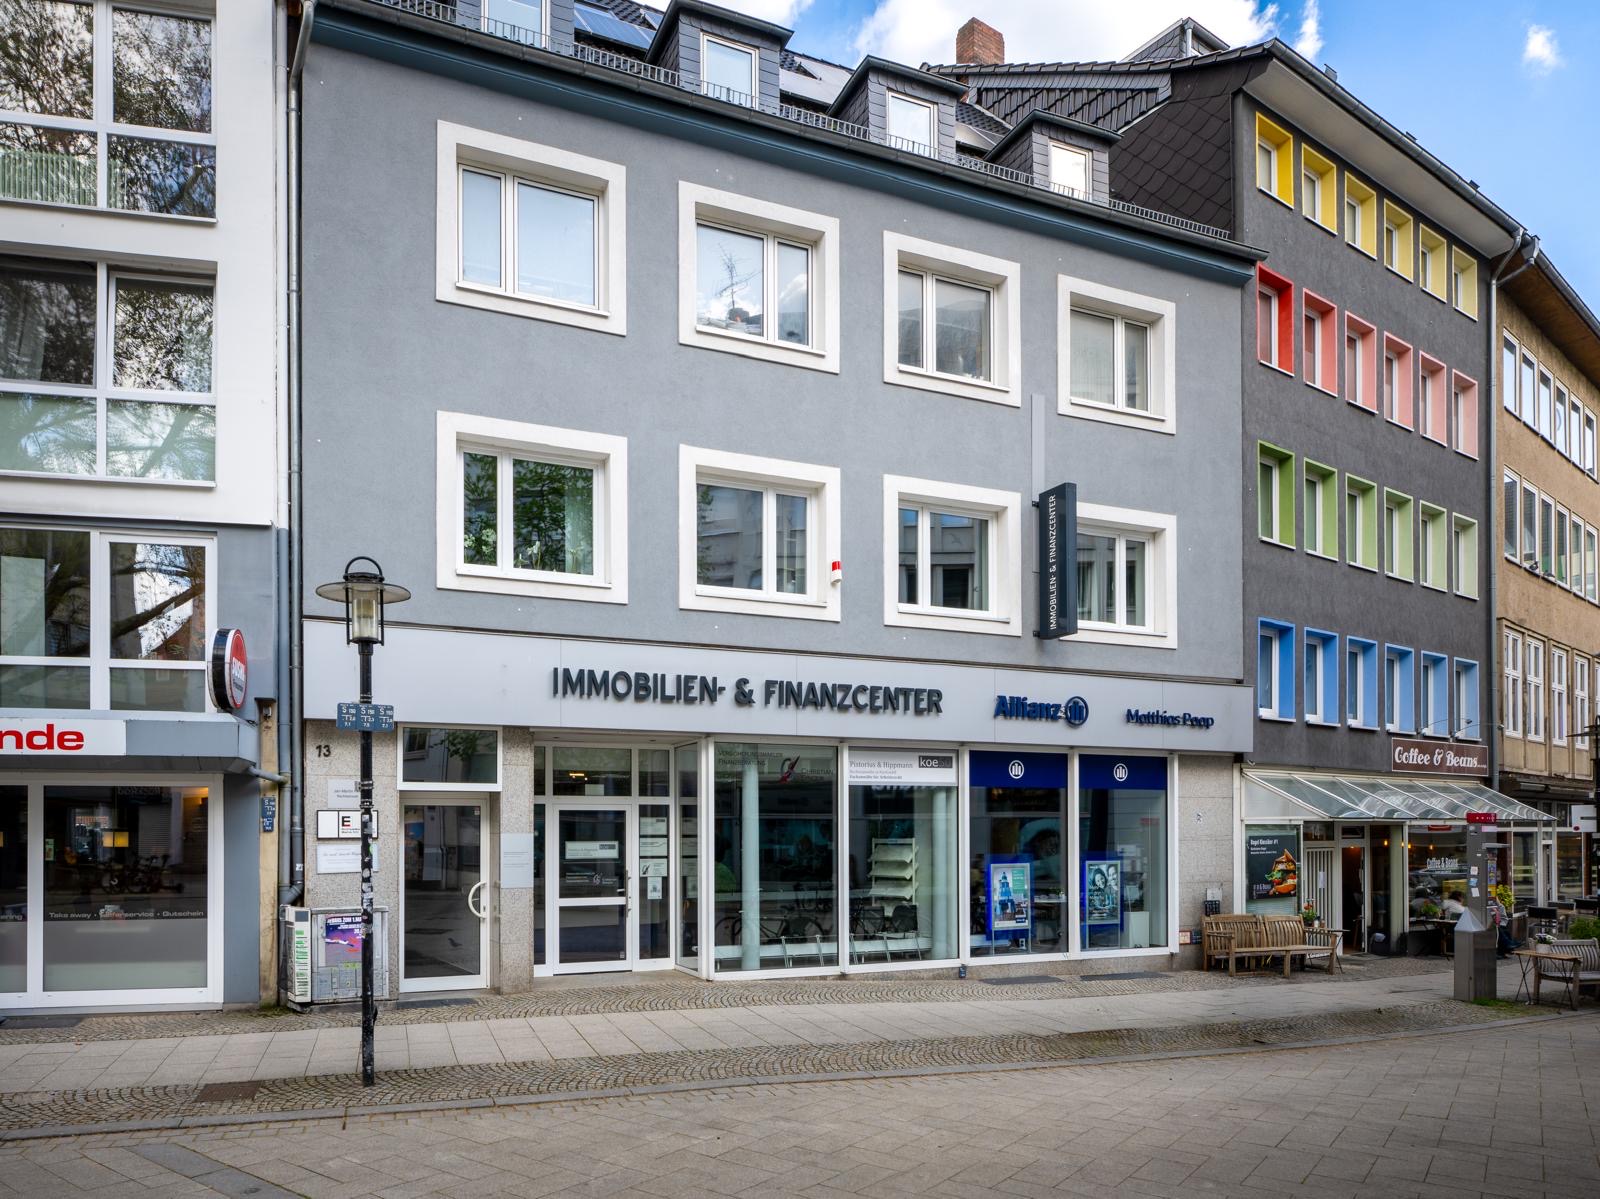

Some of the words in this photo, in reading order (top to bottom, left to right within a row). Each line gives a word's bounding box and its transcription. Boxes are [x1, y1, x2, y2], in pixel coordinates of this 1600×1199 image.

[552, 667, 726, 703] IMMOBILIEN-
[734, 677, 756, 706] &
[764, 679, 942, 714] FINANZCENTER
[994, 695, 1062, 721] Allianz
[1126, 708, 1181, 726] Matthias
[1182, 712, 1214, 730] Paap
[316, 744, 331, 757] 13
[1394, 746, 1430, 765] Coffee
[1433, 748, 1444, 766] &
[341, 816, 351, 827] E
